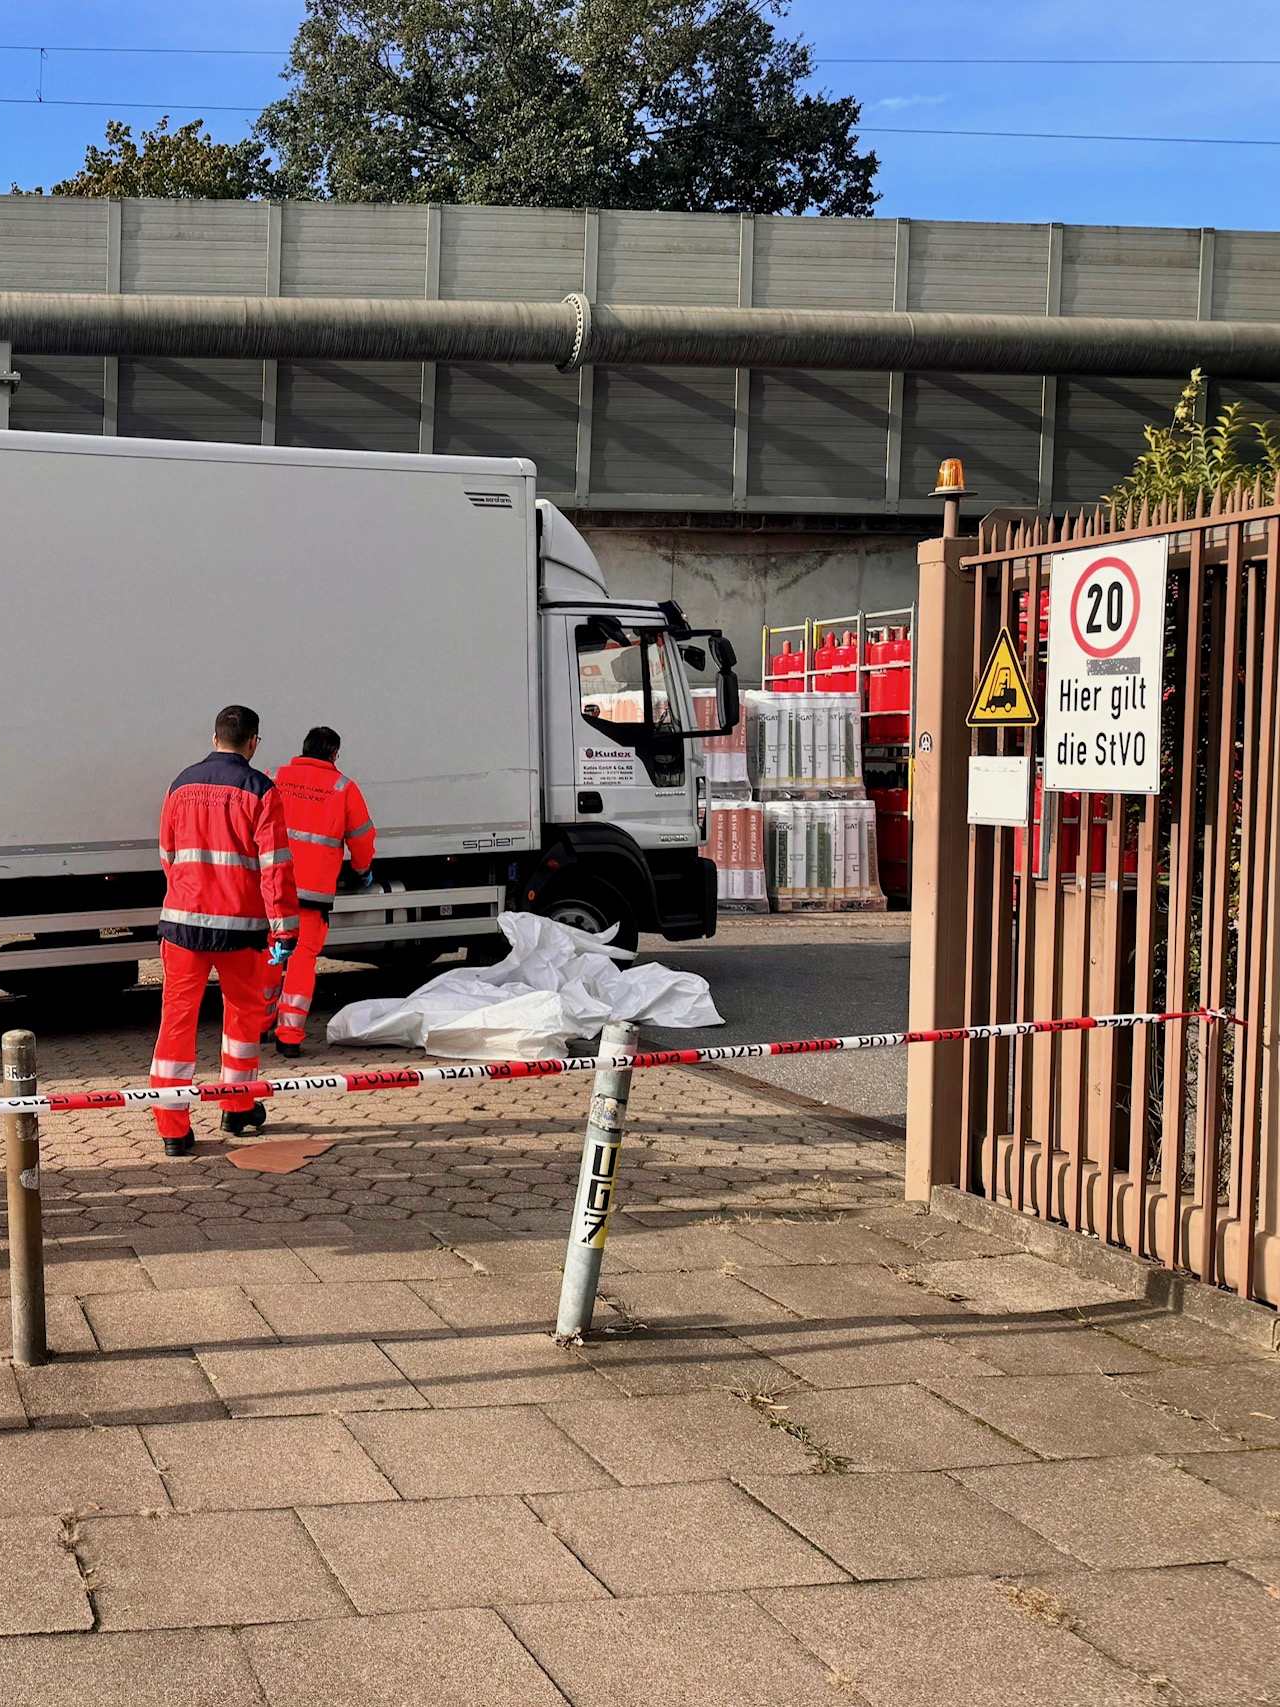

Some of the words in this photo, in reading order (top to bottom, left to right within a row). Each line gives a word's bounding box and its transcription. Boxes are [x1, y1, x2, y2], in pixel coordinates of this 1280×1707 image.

[1085, 580, 1124, 634] 20
[1059, 677, 1103, 713] Hier
[1110, 675, 1147, 720] gilt
[594, 750, 631, 758] Kudex
[1057, 732, 1087, 766] die
[1095, 731, 1146, 767] StVO
[462, 832, 526, 852] spier
[525, 1057, 596, 1074] POLIZEI
[695, 1044, 764, 1061] POLIZEI
